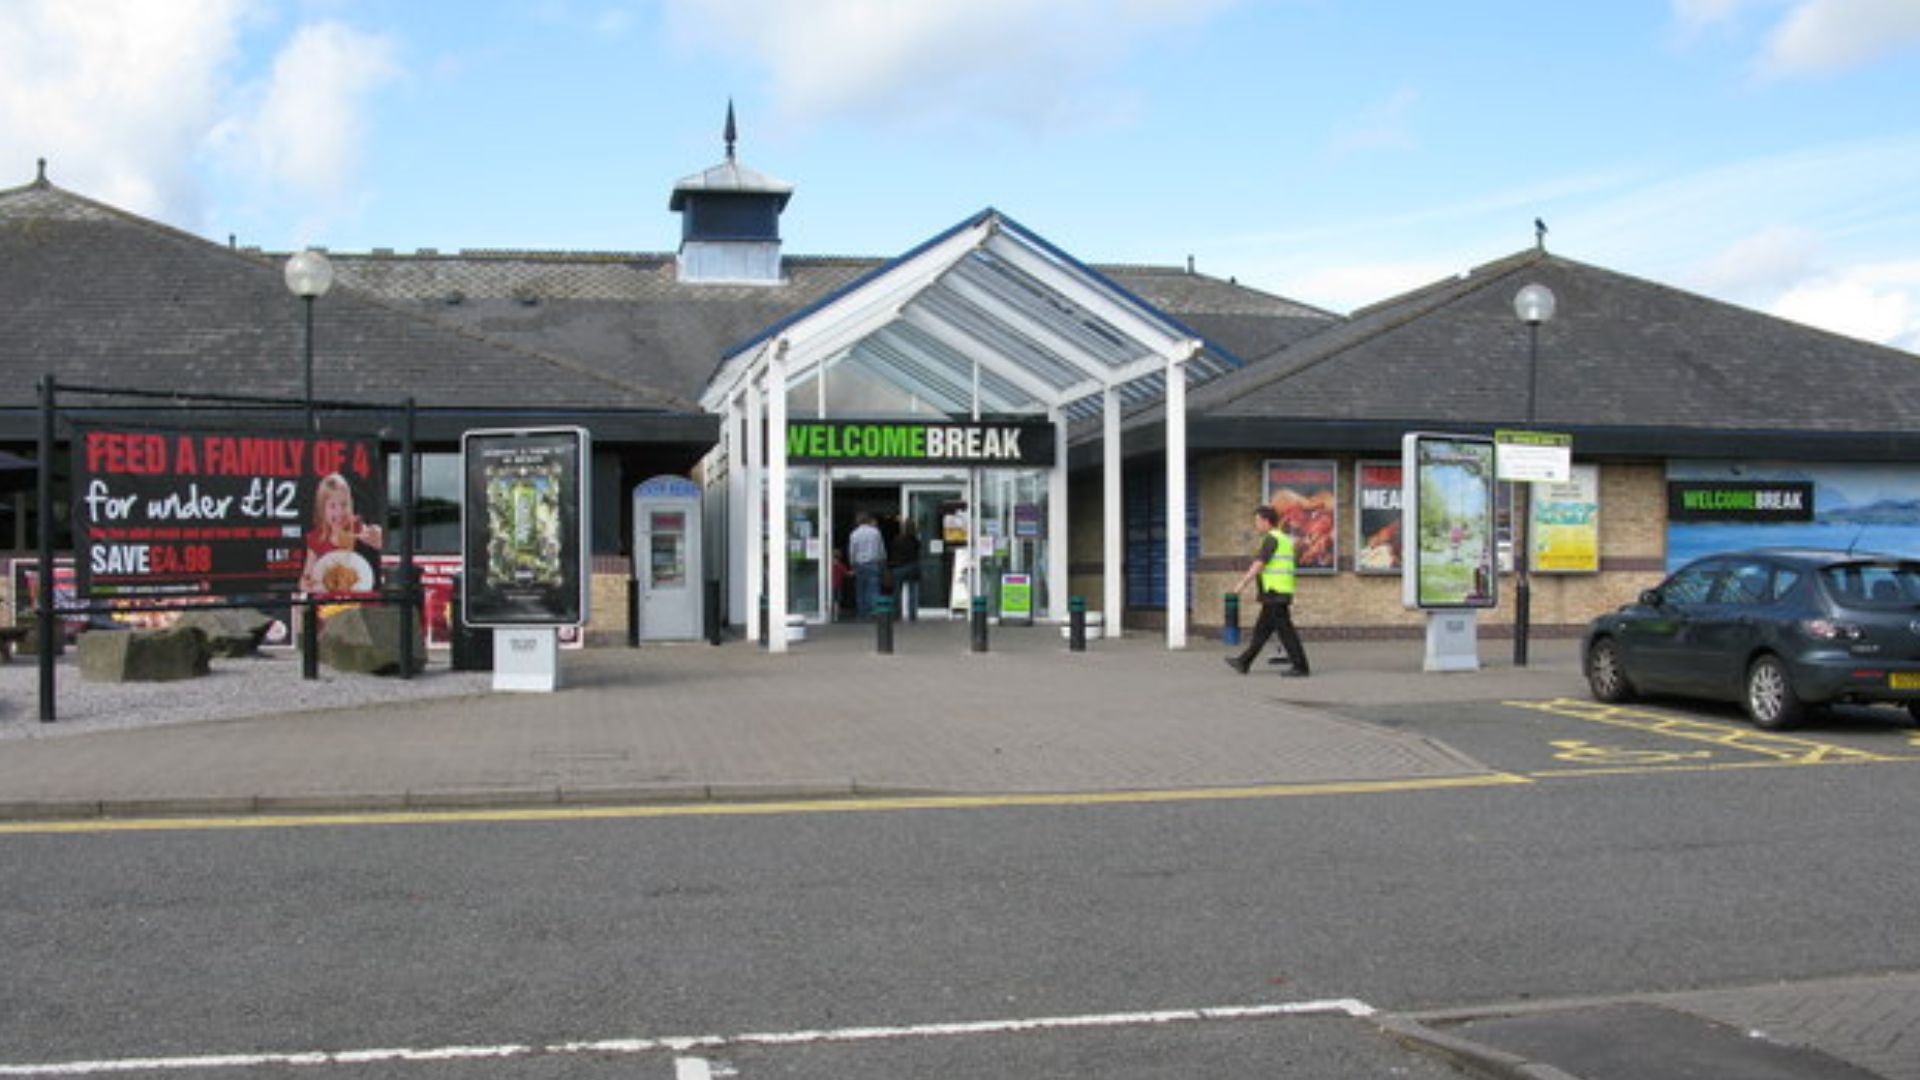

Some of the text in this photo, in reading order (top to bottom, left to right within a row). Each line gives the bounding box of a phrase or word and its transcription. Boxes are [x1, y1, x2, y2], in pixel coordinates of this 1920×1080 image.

[85, 432, 370, 479] FEED A FAMILY OF 4
[84, 477, 299, 523] for under £12
